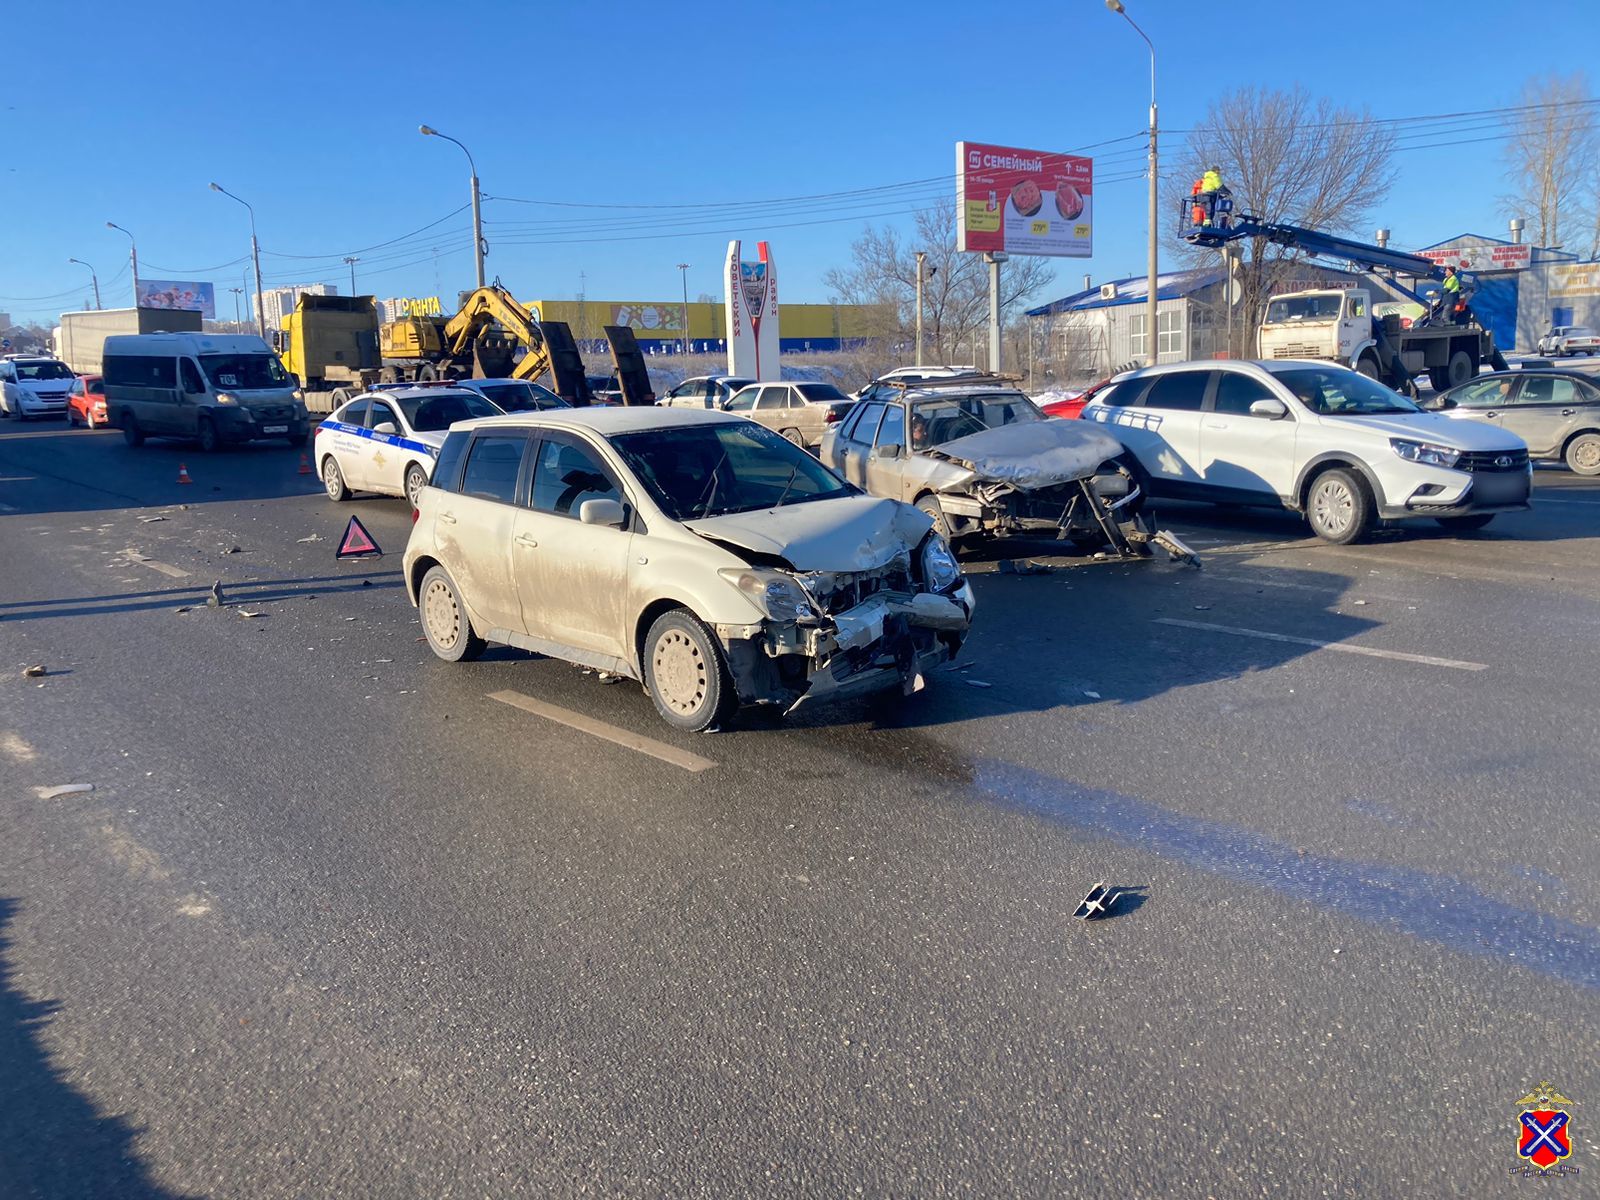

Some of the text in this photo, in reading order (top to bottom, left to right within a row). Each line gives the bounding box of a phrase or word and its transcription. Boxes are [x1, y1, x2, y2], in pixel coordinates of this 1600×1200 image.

[983, 153, 1043, 173] СЕМЕЙНЫЙ
[731, 254, 741, 337] СОВЕТСКИЙ
[411, 296, 440, 317] ЛЕНТА
